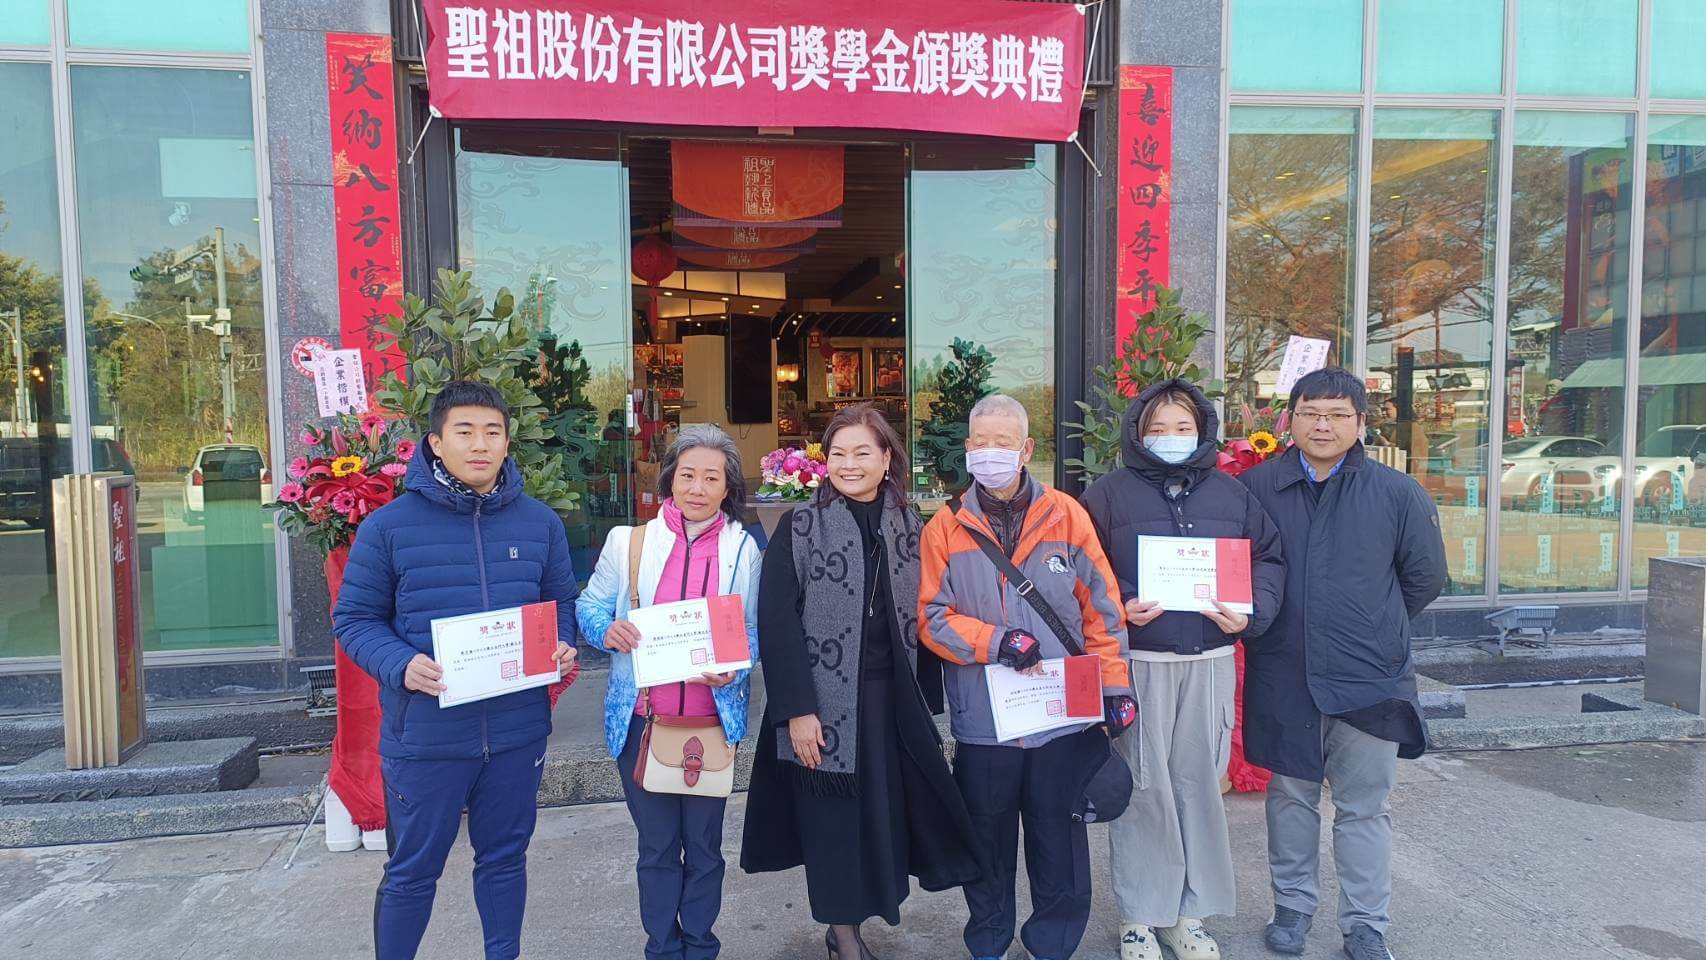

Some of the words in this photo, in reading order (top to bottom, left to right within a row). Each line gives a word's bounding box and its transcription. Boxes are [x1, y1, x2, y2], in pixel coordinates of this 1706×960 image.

[445, 5, 1064, 104] 聖祖股份有限公司獎學金頒獎典禮
[112, 501, 126, 564] 聖祖
